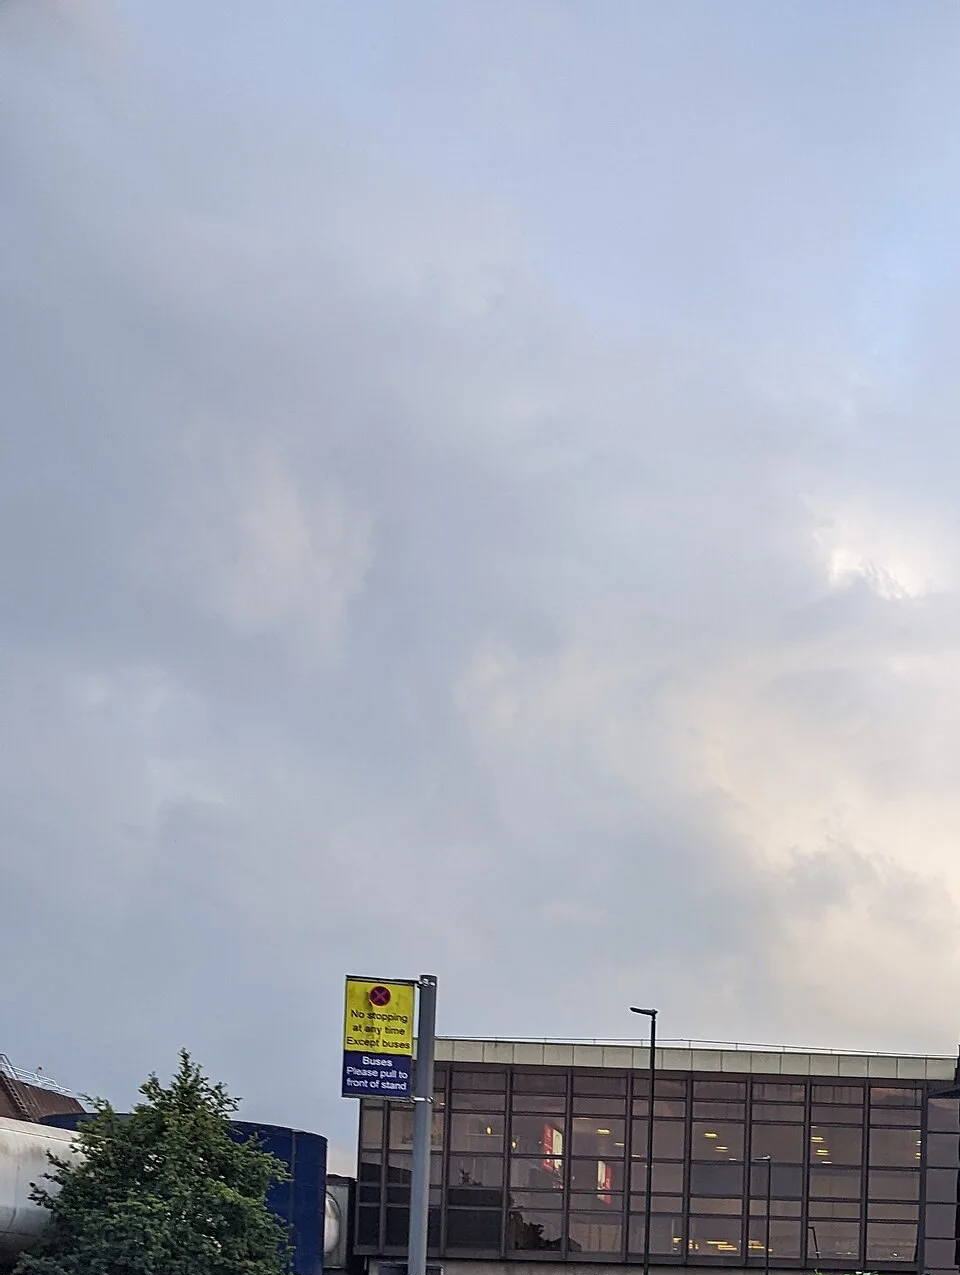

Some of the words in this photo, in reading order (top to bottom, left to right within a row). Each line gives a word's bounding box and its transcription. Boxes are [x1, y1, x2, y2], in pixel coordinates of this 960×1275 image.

[351, 1010, 364, 1019] No
[367, 1012, 408, 1024] stopping
[352, 1024, 362, 1032] at
[365, 1026, 381, 1035] any
[384, 1026, 405, 1035] time
[346, 1036, 379, 1048] Except
[382, 1040, 410, 1049] buses
[362, 1056, 393, 1067] Buses
[346, 1067, 378, 1077] Please
[380, 1069, 396, 1079] pull
[398, 1070, 408, 1079] to
[346, 1078, 368, 1087] front
[369, 1079, 380, 1089] of
[381, 1081, 406, 1090] stand
